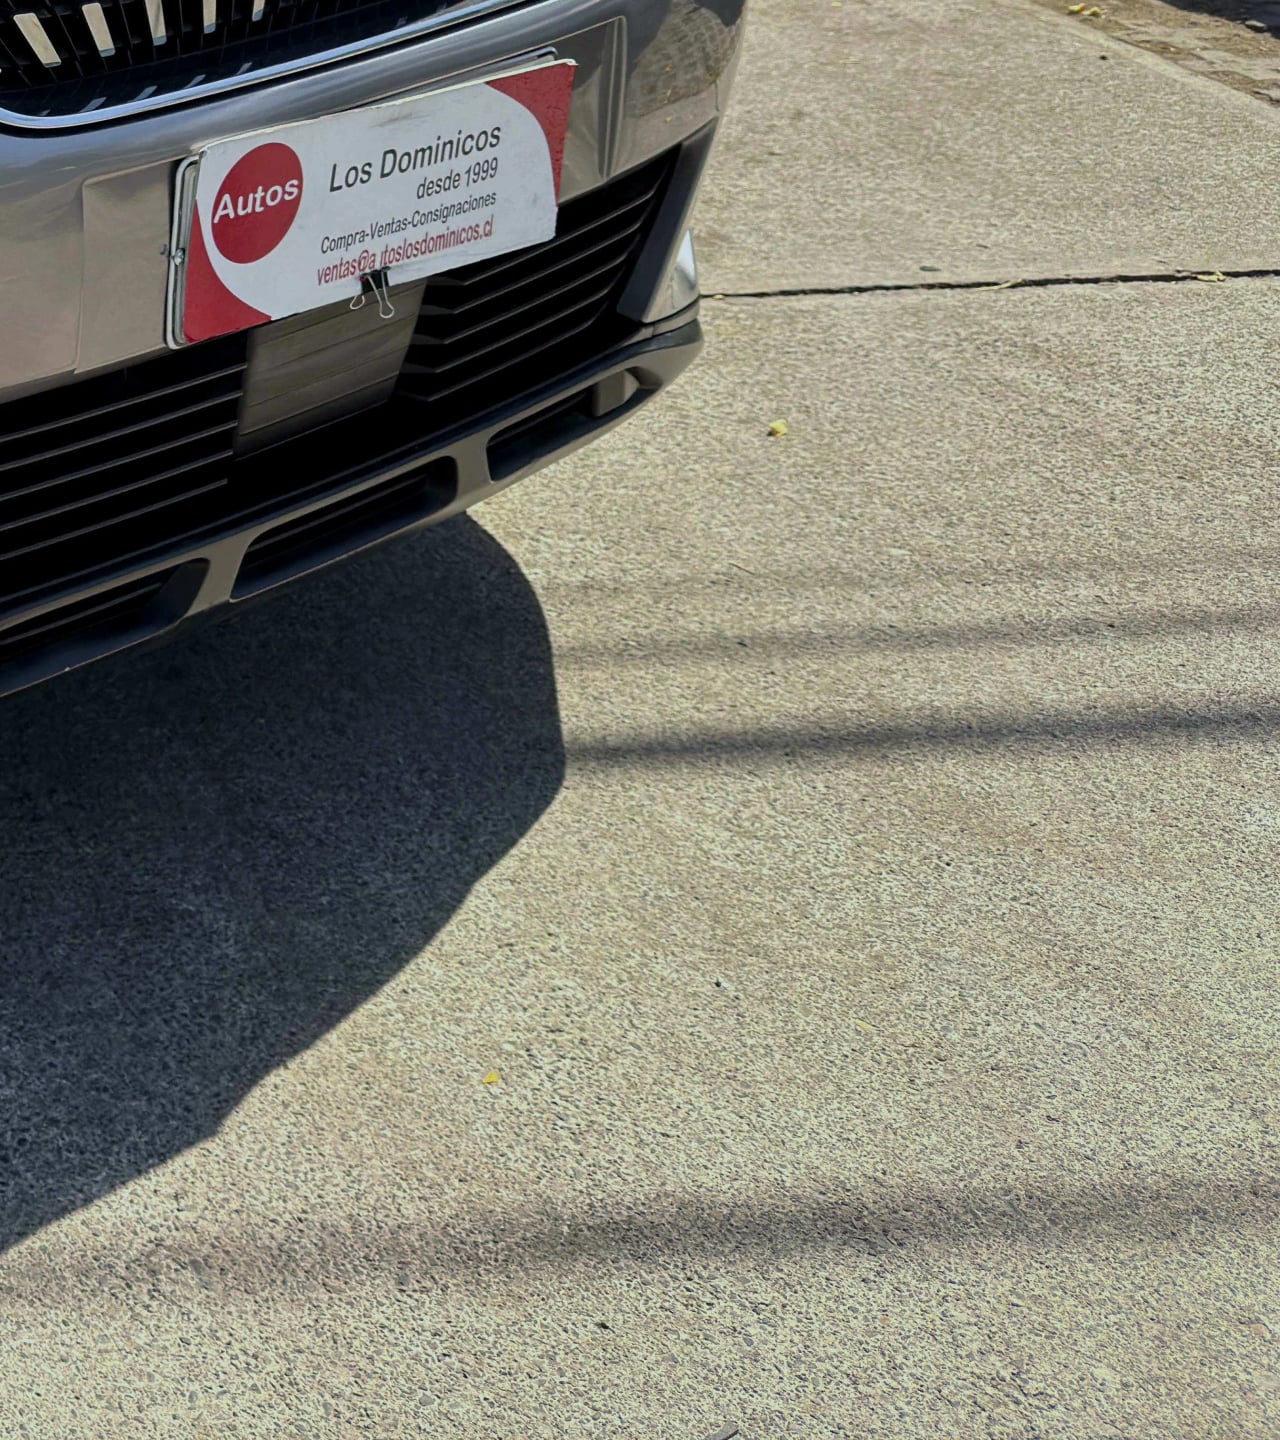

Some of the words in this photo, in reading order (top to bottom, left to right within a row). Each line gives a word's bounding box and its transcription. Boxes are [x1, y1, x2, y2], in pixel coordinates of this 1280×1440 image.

[329, 162, 372, 192] Los
[380, 126, 501, 179] Dominicos
[416, 177, 461, 200] desde
[464, 157, 498, 188] 1999
[213, 178, 300, 224] Autos
[320, 191, 496, 254] Compra-Ventas-Consignaciones
